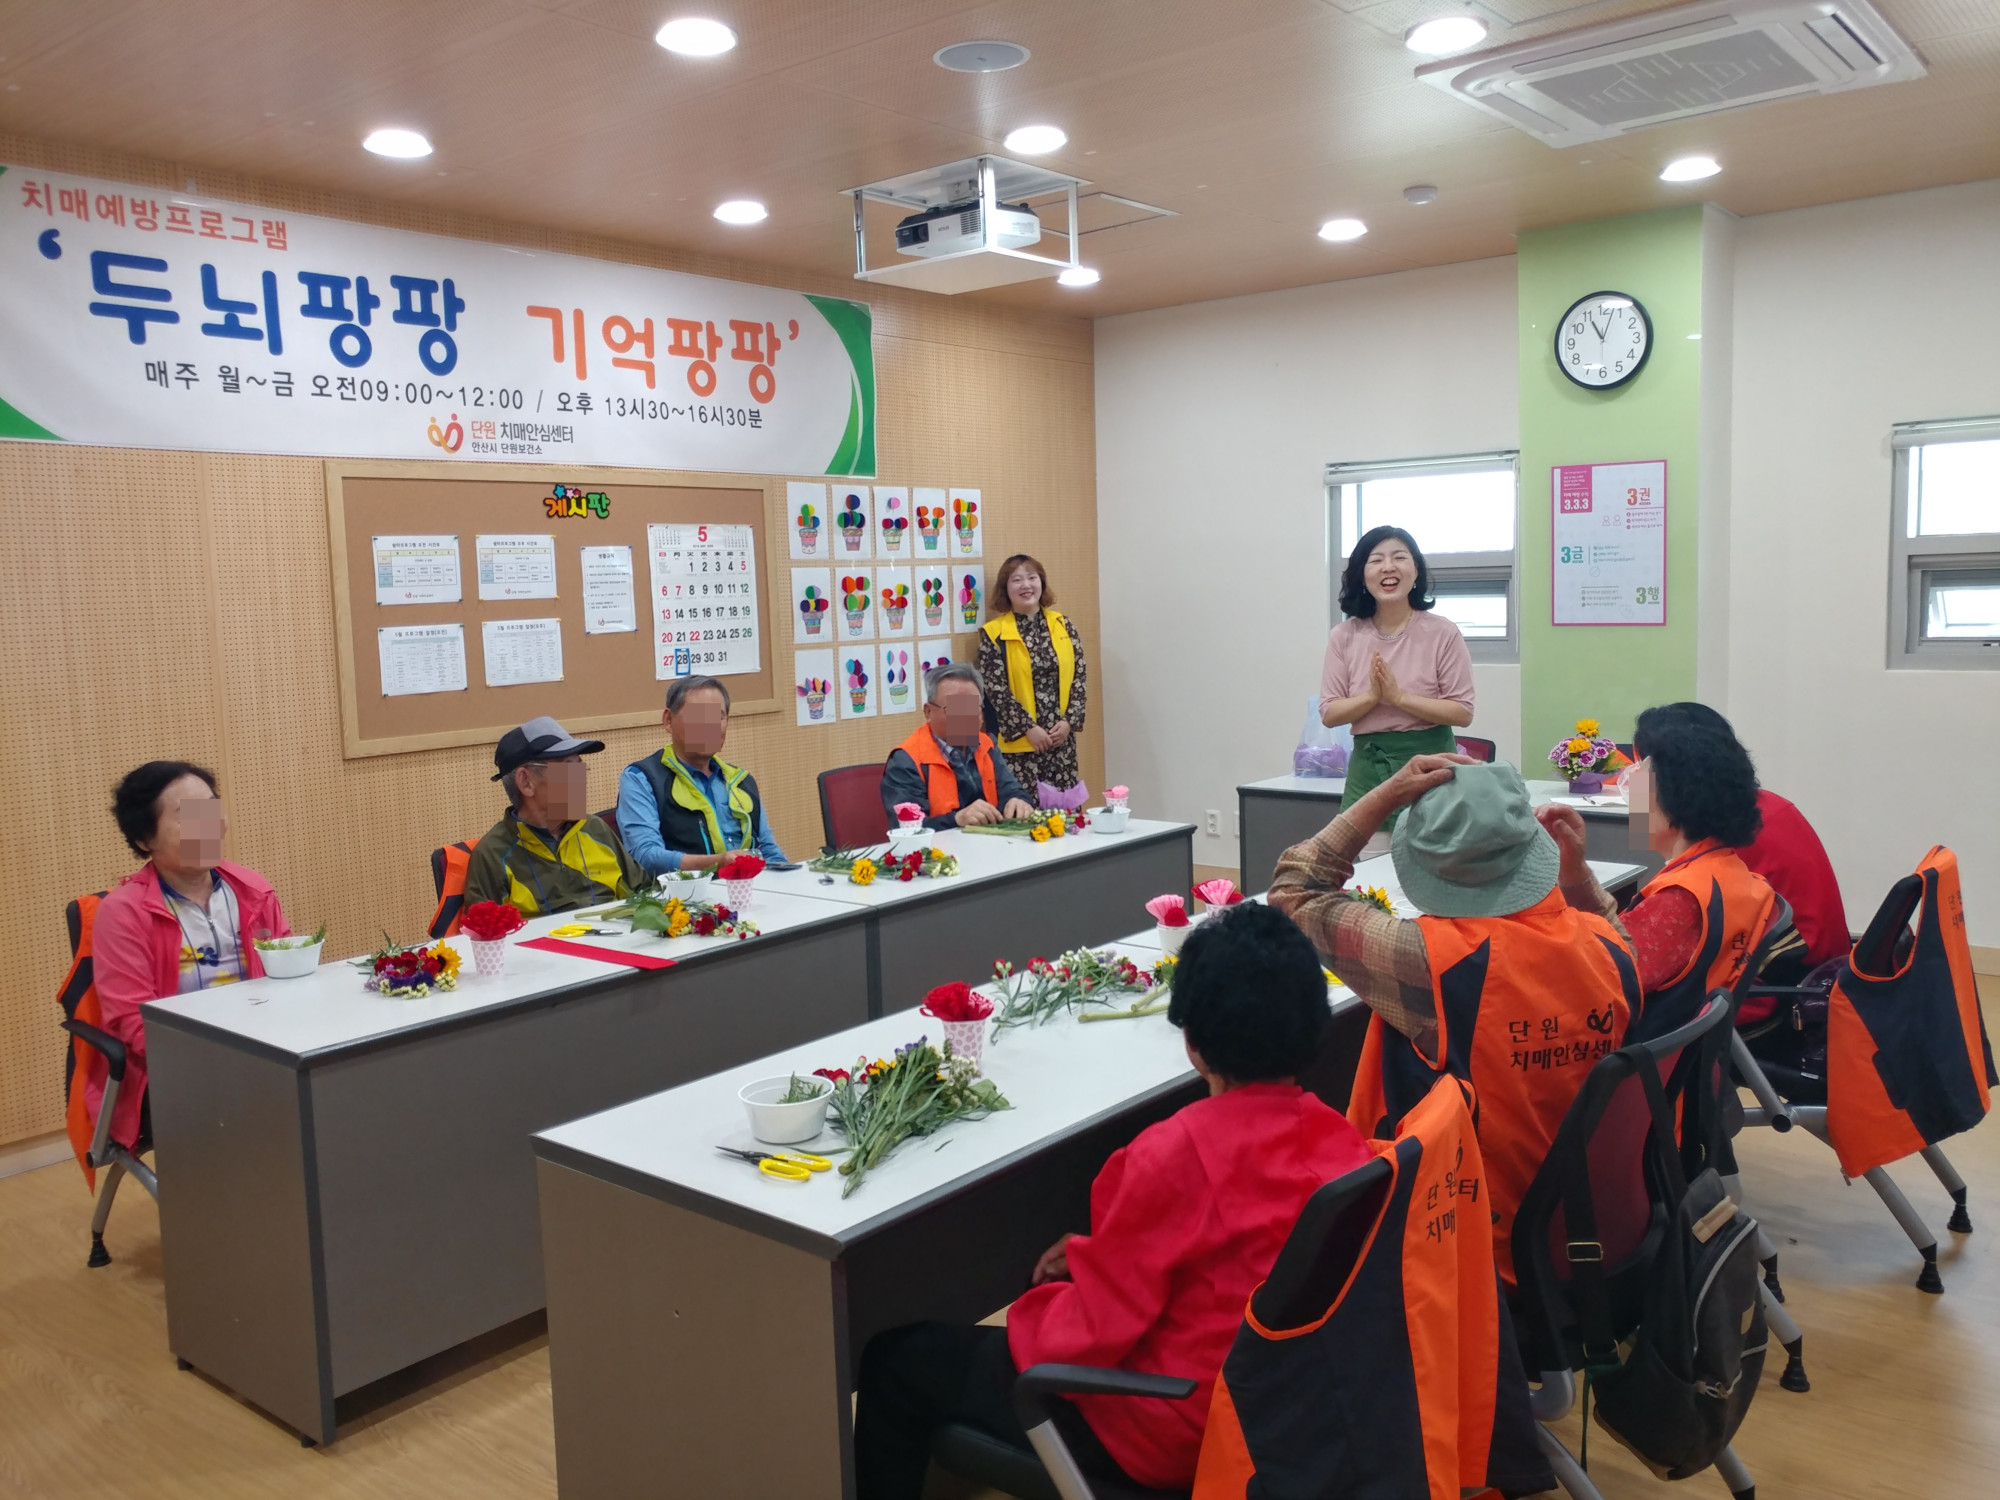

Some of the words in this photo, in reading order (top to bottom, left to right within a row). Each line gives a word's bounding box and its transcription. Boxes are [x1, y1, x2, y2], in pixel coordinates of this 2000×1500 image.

[21, 179, 288, 251] 치매예방프로그램
[1583, 310, 1592, 322] 11
[1571, 323, 1584, 335] 10
[1628, 317, 1637, 329] 2
[1567, 338, 1575, 350] 9
[1632, 332, 1640, 344] 3
[1572, 353, 1580, 365] 8
[1627, 348, 1635, 360] 4
[1599, 366, 1607, 378] 6
[1615, 361, 1623, 373] 5
[145, 360, 201, 391] 매주
[216, 364, 295, 398] 월~금
[310, 374, 524, 410] 오전09:00~12:00
[536, 389, 544, 413] /
[556, 391, 594, 415] 오후
[604, 397, 763, 430] 13시30~16시30분
[471, 420, 496, 440] 단원
[500, 421, 574, 444] 치매안심센터
[471, 441, 498, 453] 안산시
[501, 443, 543, 455] 단원보건소
[543, 492, 610, 518] 게시판
[1564, 498, 1589, 510] 3.3.3
[698, 526, 708, 542] 5
[689, 562, 694, 572] 1
[702, 562, 708, 572] 2
[715, 561, 721, 572] 3
[728, 561, 734, 571] 4
[741, 560, 747, 571] 5
[661, 585, 668, 596] 6
[675, 585, 681, 596] 7
[689, 584, 695, 595] 8
[702, 584, 708, 595] 9
[714, 584, 723, 594] 10
[728, 583, 736, 594] 11
[740, 583, 749, 594] 12
[661, 609, 671, 620] 13
[675, 609, 684, 619] 14
[688, 608, 698, 619] 15
[702, 607, 711, 618] 16
[716, 607, 725, 617] 17
[728, 606, 738, 617] 18
[742, 606, 751, 616] 19
[661, 632, 673, 643] 20
[676, 632, 686, 642] 21
[689, 631, 700, 641] 22
[703, 630, 714, 640] 23
[716, 629, 727, 640] 24
[729, 628, 740, 639] 25
[742, 628, 753, 638] 26
[663, 655, 674, 666] 27
[677, 654, 688, 665] 28
[690, 653, 701, 664] 29
[704, 652, 715, 663] 30
[718, 651, 728, 662] 31
[1510, 1040, 1616, 1071] 치매안심센
